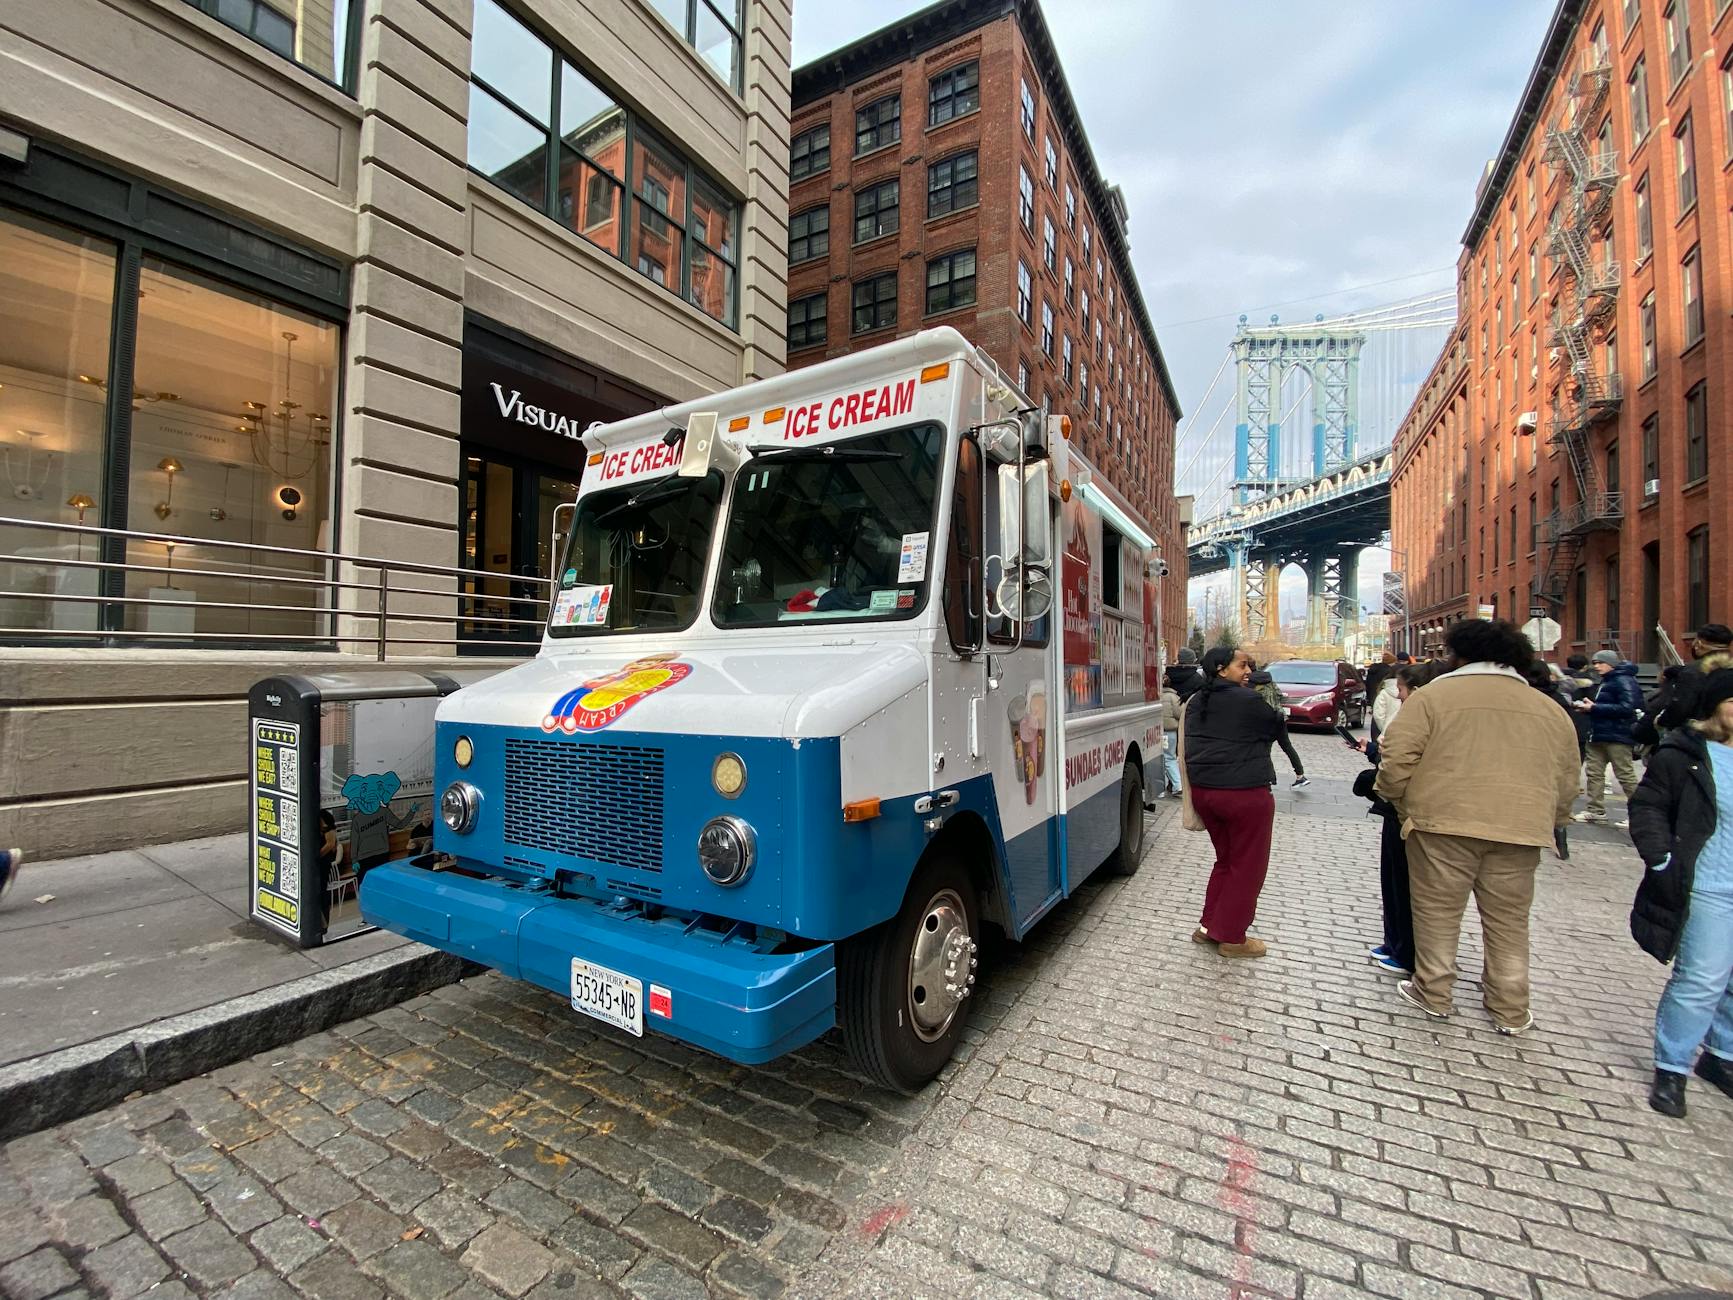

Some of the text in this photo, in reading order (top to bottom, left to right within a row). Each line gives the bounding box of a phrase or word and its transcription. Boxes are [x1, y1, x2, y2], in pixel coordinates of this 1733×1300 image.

[784, 379, 916, 440] ICE CREAM
[600, 451, 631, 481] ICE
[580, 701, 627, 727] CREAM
[1065, 739, 1125, 790] SUNDAES CONES
[589, 967, 624, 988] NEW YORK
[576, 973, 636, 1020] 55345 NB
[590, 1007, 623, 1025] COMMERCIAL
